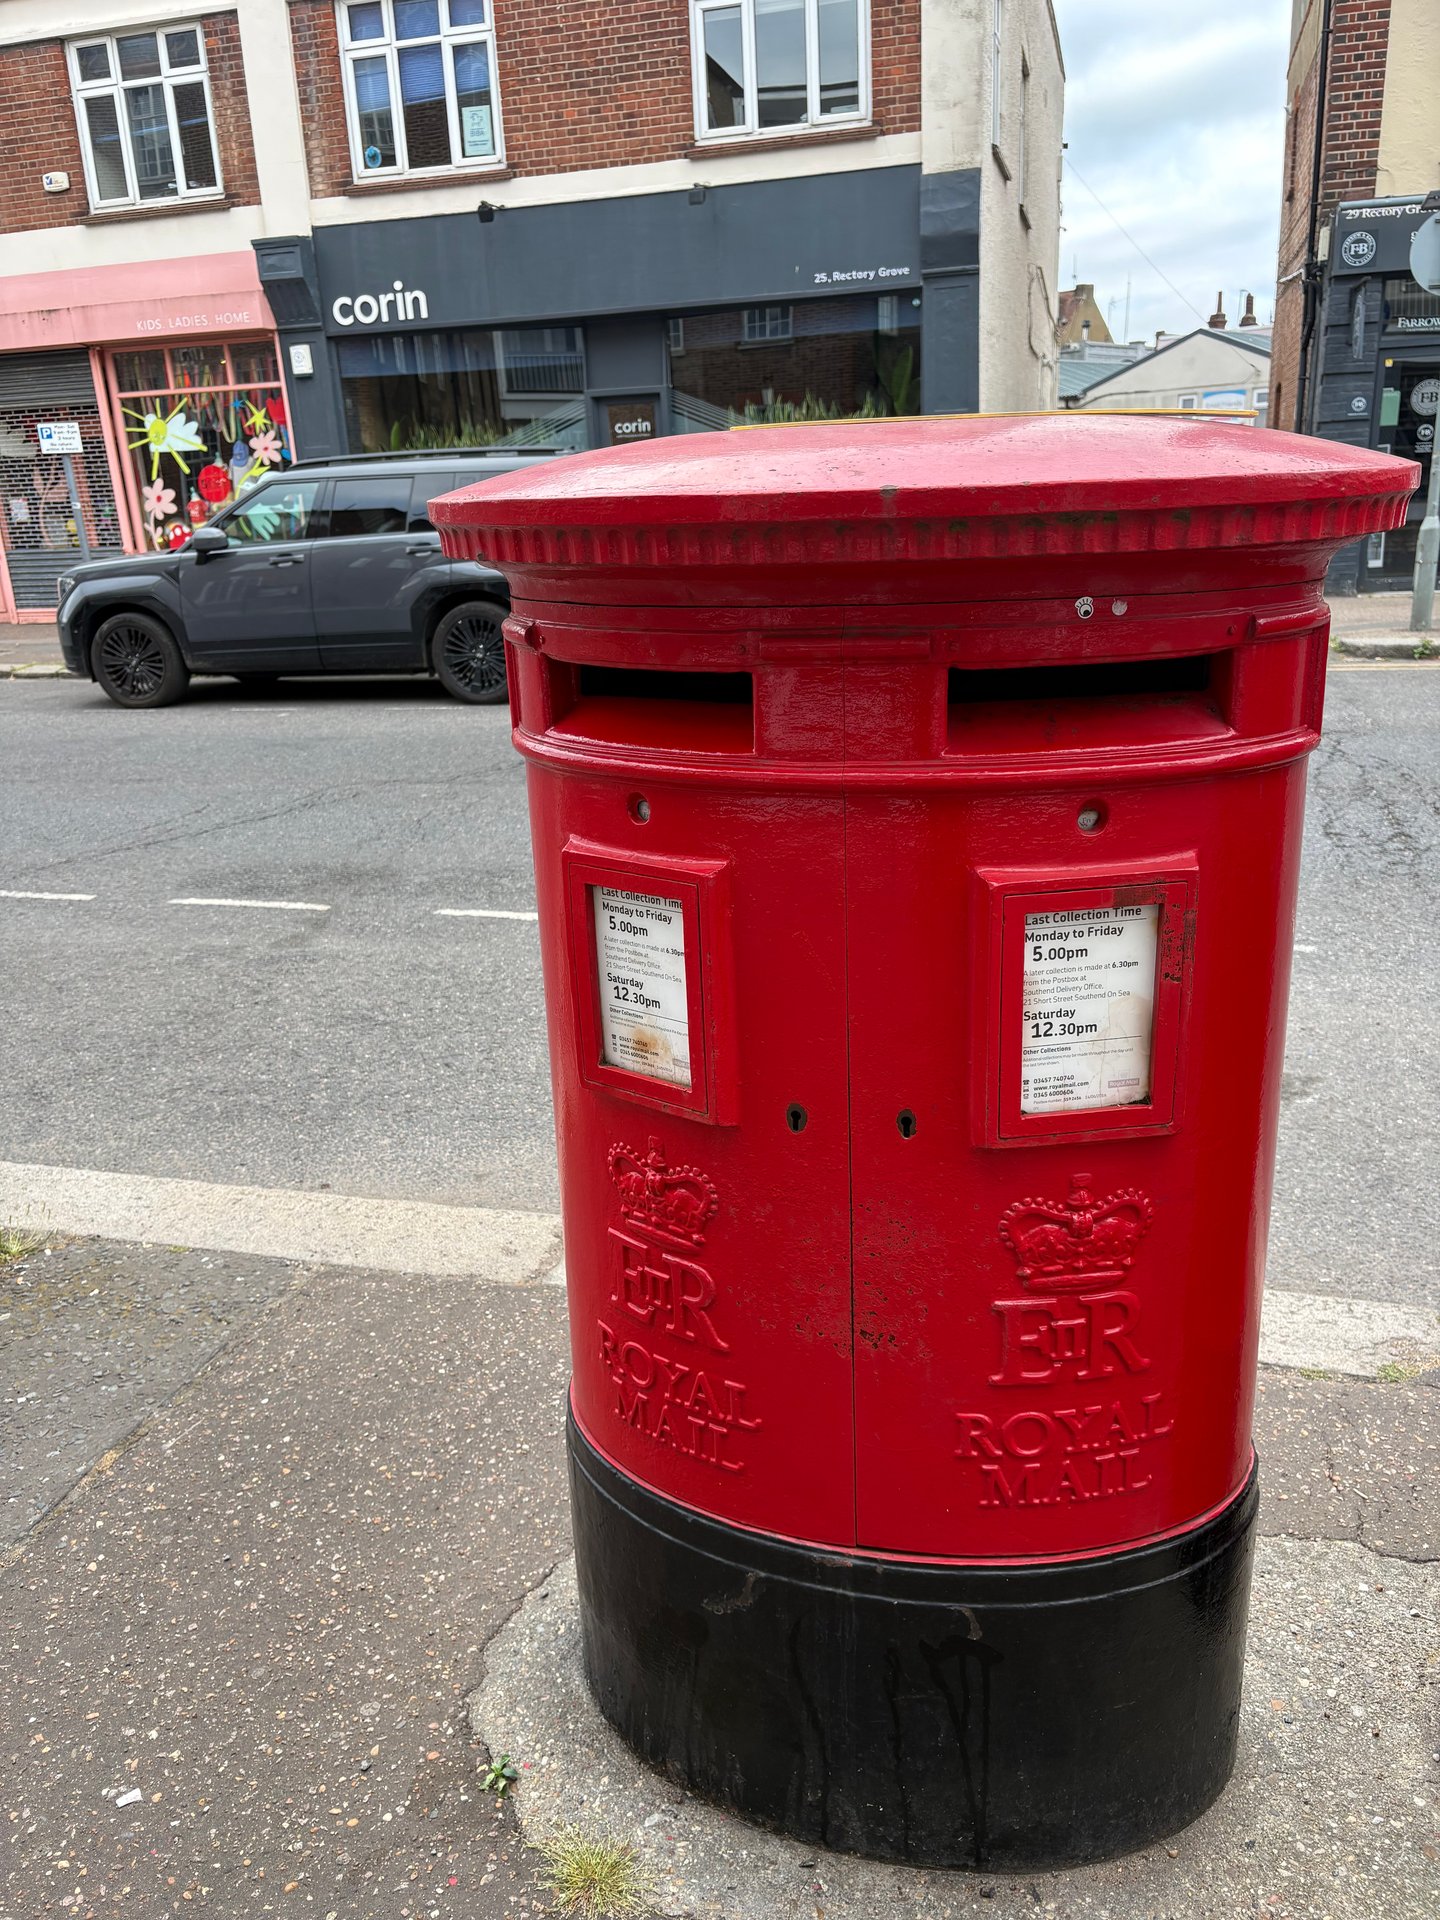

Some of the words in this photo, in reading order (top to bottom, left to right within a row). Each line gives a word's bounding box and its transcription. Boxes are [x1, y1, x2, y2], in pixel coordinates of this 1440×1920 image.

[1346, 209, 1359, 220] 29
[1361, 207, 1404, 218] Rectory
[832, 270, 876, 281] Rectory
[878, 266, 910, 277] Grove
[332, 280, 428, 326] corin
[136, 318, 166, 331] KIDS.
[168, 314, 212, 328] LADIES.
[215, 311, 254, 324] HOME.
[614, 418, 651, 434] corin
[602, 887, 619, 898] Last
[620, 890, 660, 906] Collection
[602, 902, 634, 918] Monday
[636, 908, 644, 918] to
[646, 910, 672, 924] Friday
[1025, 915, 1050, 926] Last
[1053, 910, 1110, 923] Collection
[1112, 906, 1142, 918] Time
[609, 916, 648, 936] 5.00pm
[1025, 930, 1070, 942] Monday
[1073, 929, 1084, 938] to
[1088, 926, 1124, 937] Friday
[1032, 946, 1088, 962] 5.00pm
[1046, 966, 1076, 975] collection
[1112, 960, 1139, 969] 6.30pm
[607, 972, 644, 990] Saturday
[1053, 976, 1078, 984] Postbox
[613, 986, 661, 1009] 12.30pm
[1023, 987, 1054, 996] Southend
[1056, 985, 1082, 993] Delivery
[1023, 998, 1032, 1006] 21
[1053, 995, 1073, 1003] Street
[1074, 992, 1106, 1000] Southend
[1023, 1008, 1076, 1021] Saturday
[1031, 1022, 1098, 1038] 12.30pm
[1040, 1046, 1072, 1054] Collections
[1034, 1081, 1089, 1091] www.royalmail.com
[598, 1320, 762, 1429] ROYAL
[612, 1375, 745, 1470] MAIL
[954, 1392, 1175, 1458] ROYAL
[978, 1448, 1152, 1506] MAIL
